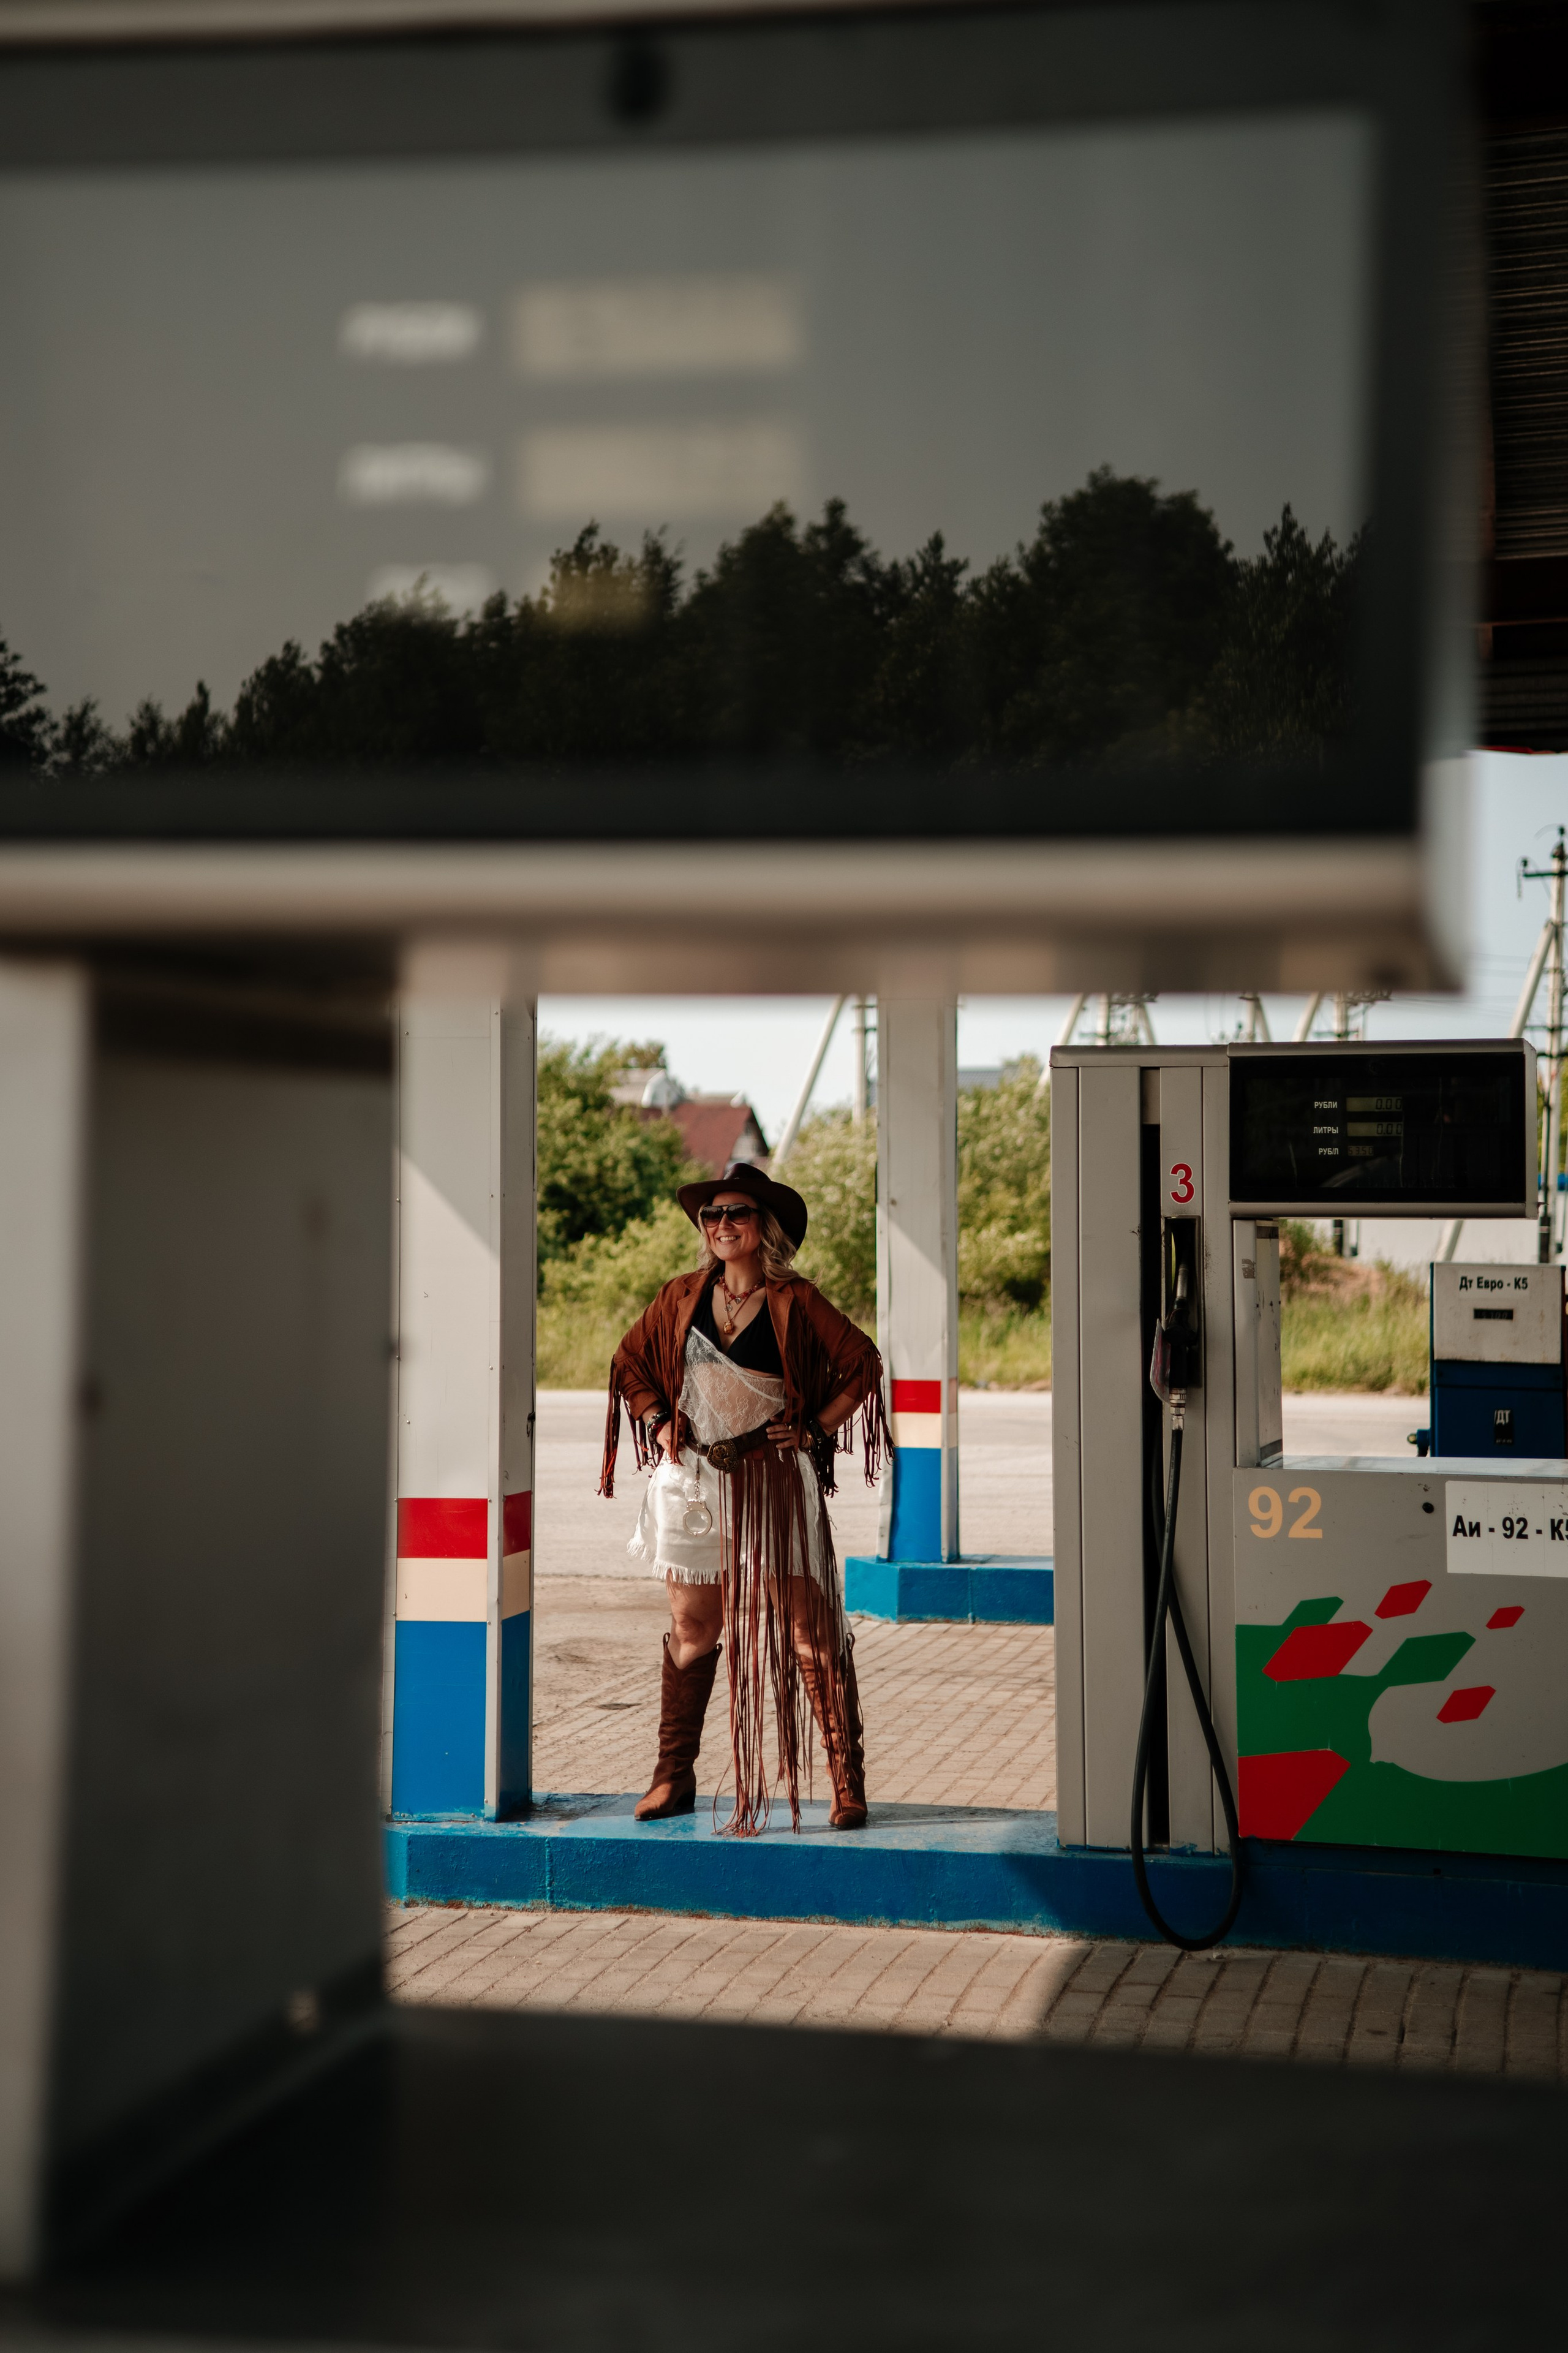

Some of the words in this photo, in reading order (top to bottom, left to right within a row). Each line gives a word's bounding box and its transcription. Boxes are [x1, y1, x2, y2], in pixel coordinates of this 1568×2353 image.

[1169, 1162, 1195, 1205] 3
[1459, 1275, 1473, 1291] Дт
[1476, 1276, 1504, 1292] Евро
[1248, 1486, 1322, 1538] 92
[1452, 1514, 1481, 1538] Аи
[1502, 1516, 1529, 1539] 92
[1550, 1518, 1568, 1541] К
